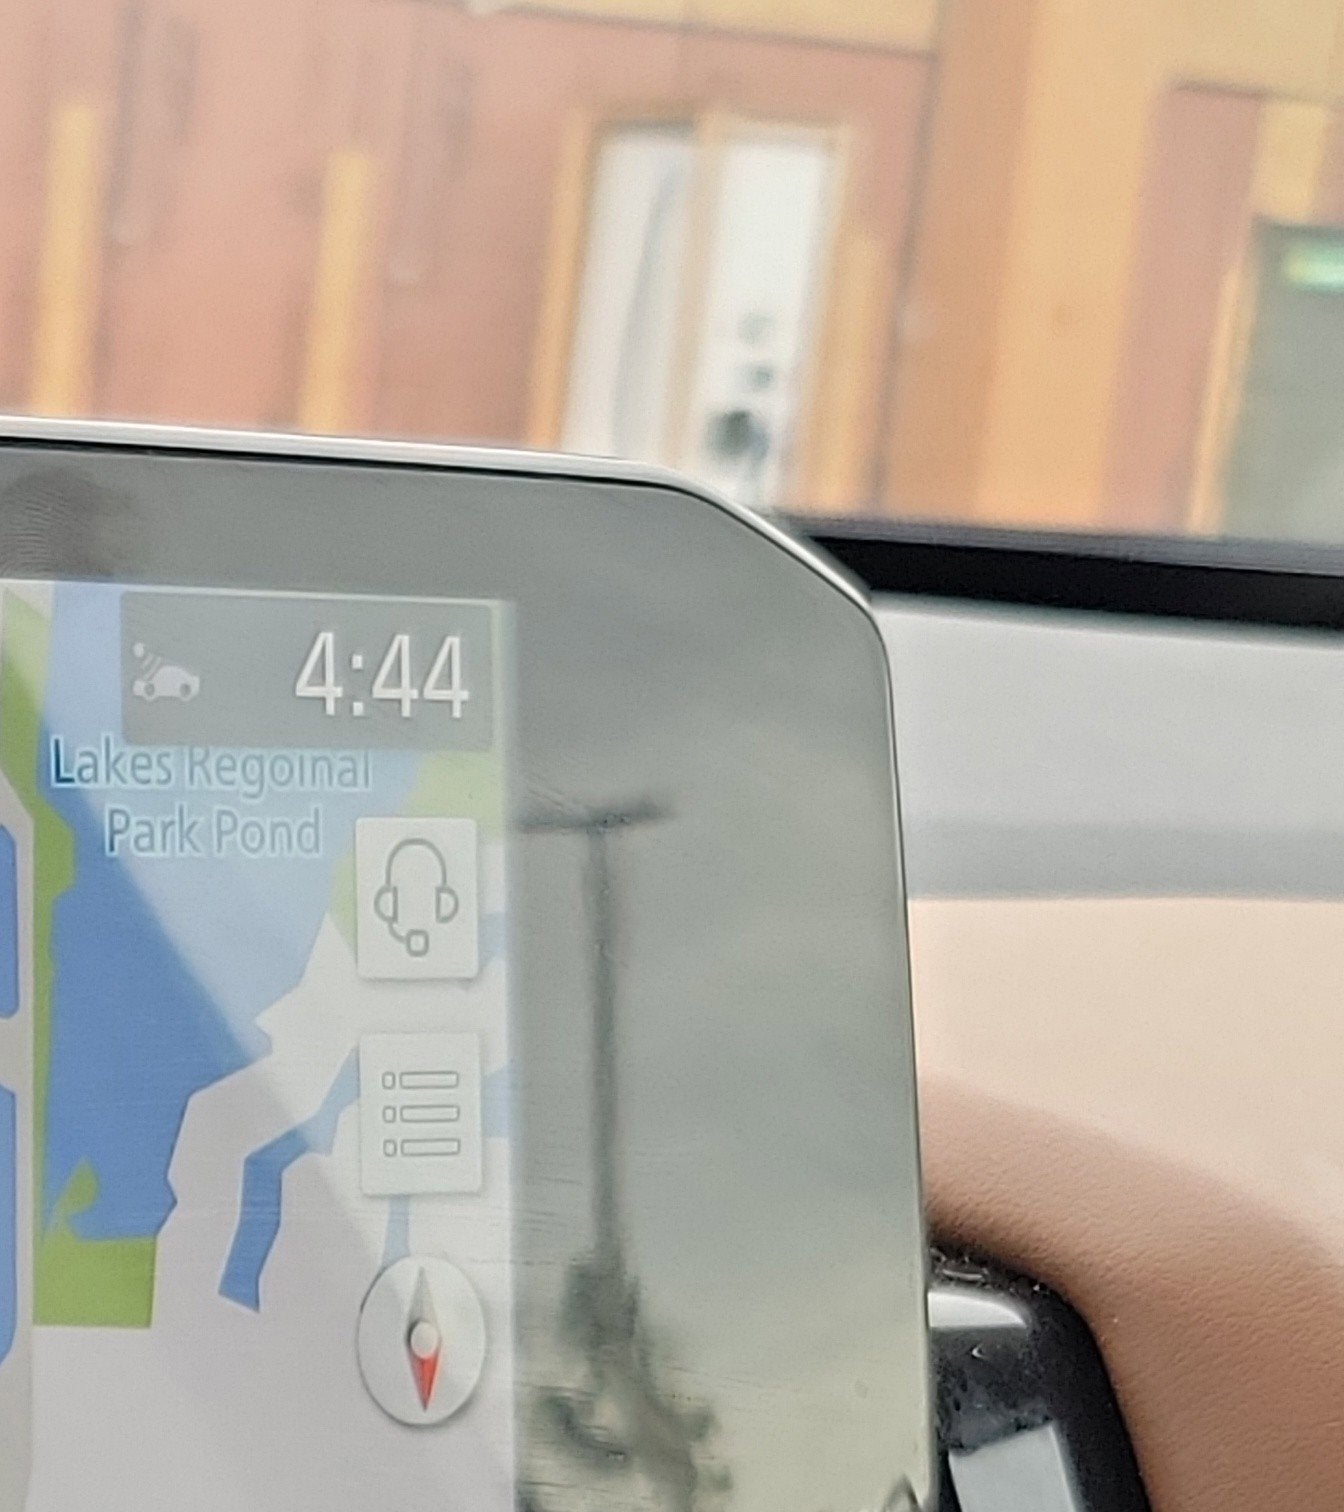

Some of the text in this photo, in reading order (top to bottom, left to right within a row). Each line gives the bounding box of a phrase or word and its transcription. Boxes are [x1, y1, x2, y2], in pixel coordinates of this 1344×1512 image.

[295, 630, 470, 719] 4:44
[51, 735, 172, 787] Lakes
[107, 804, 322, 855] Park Pond
